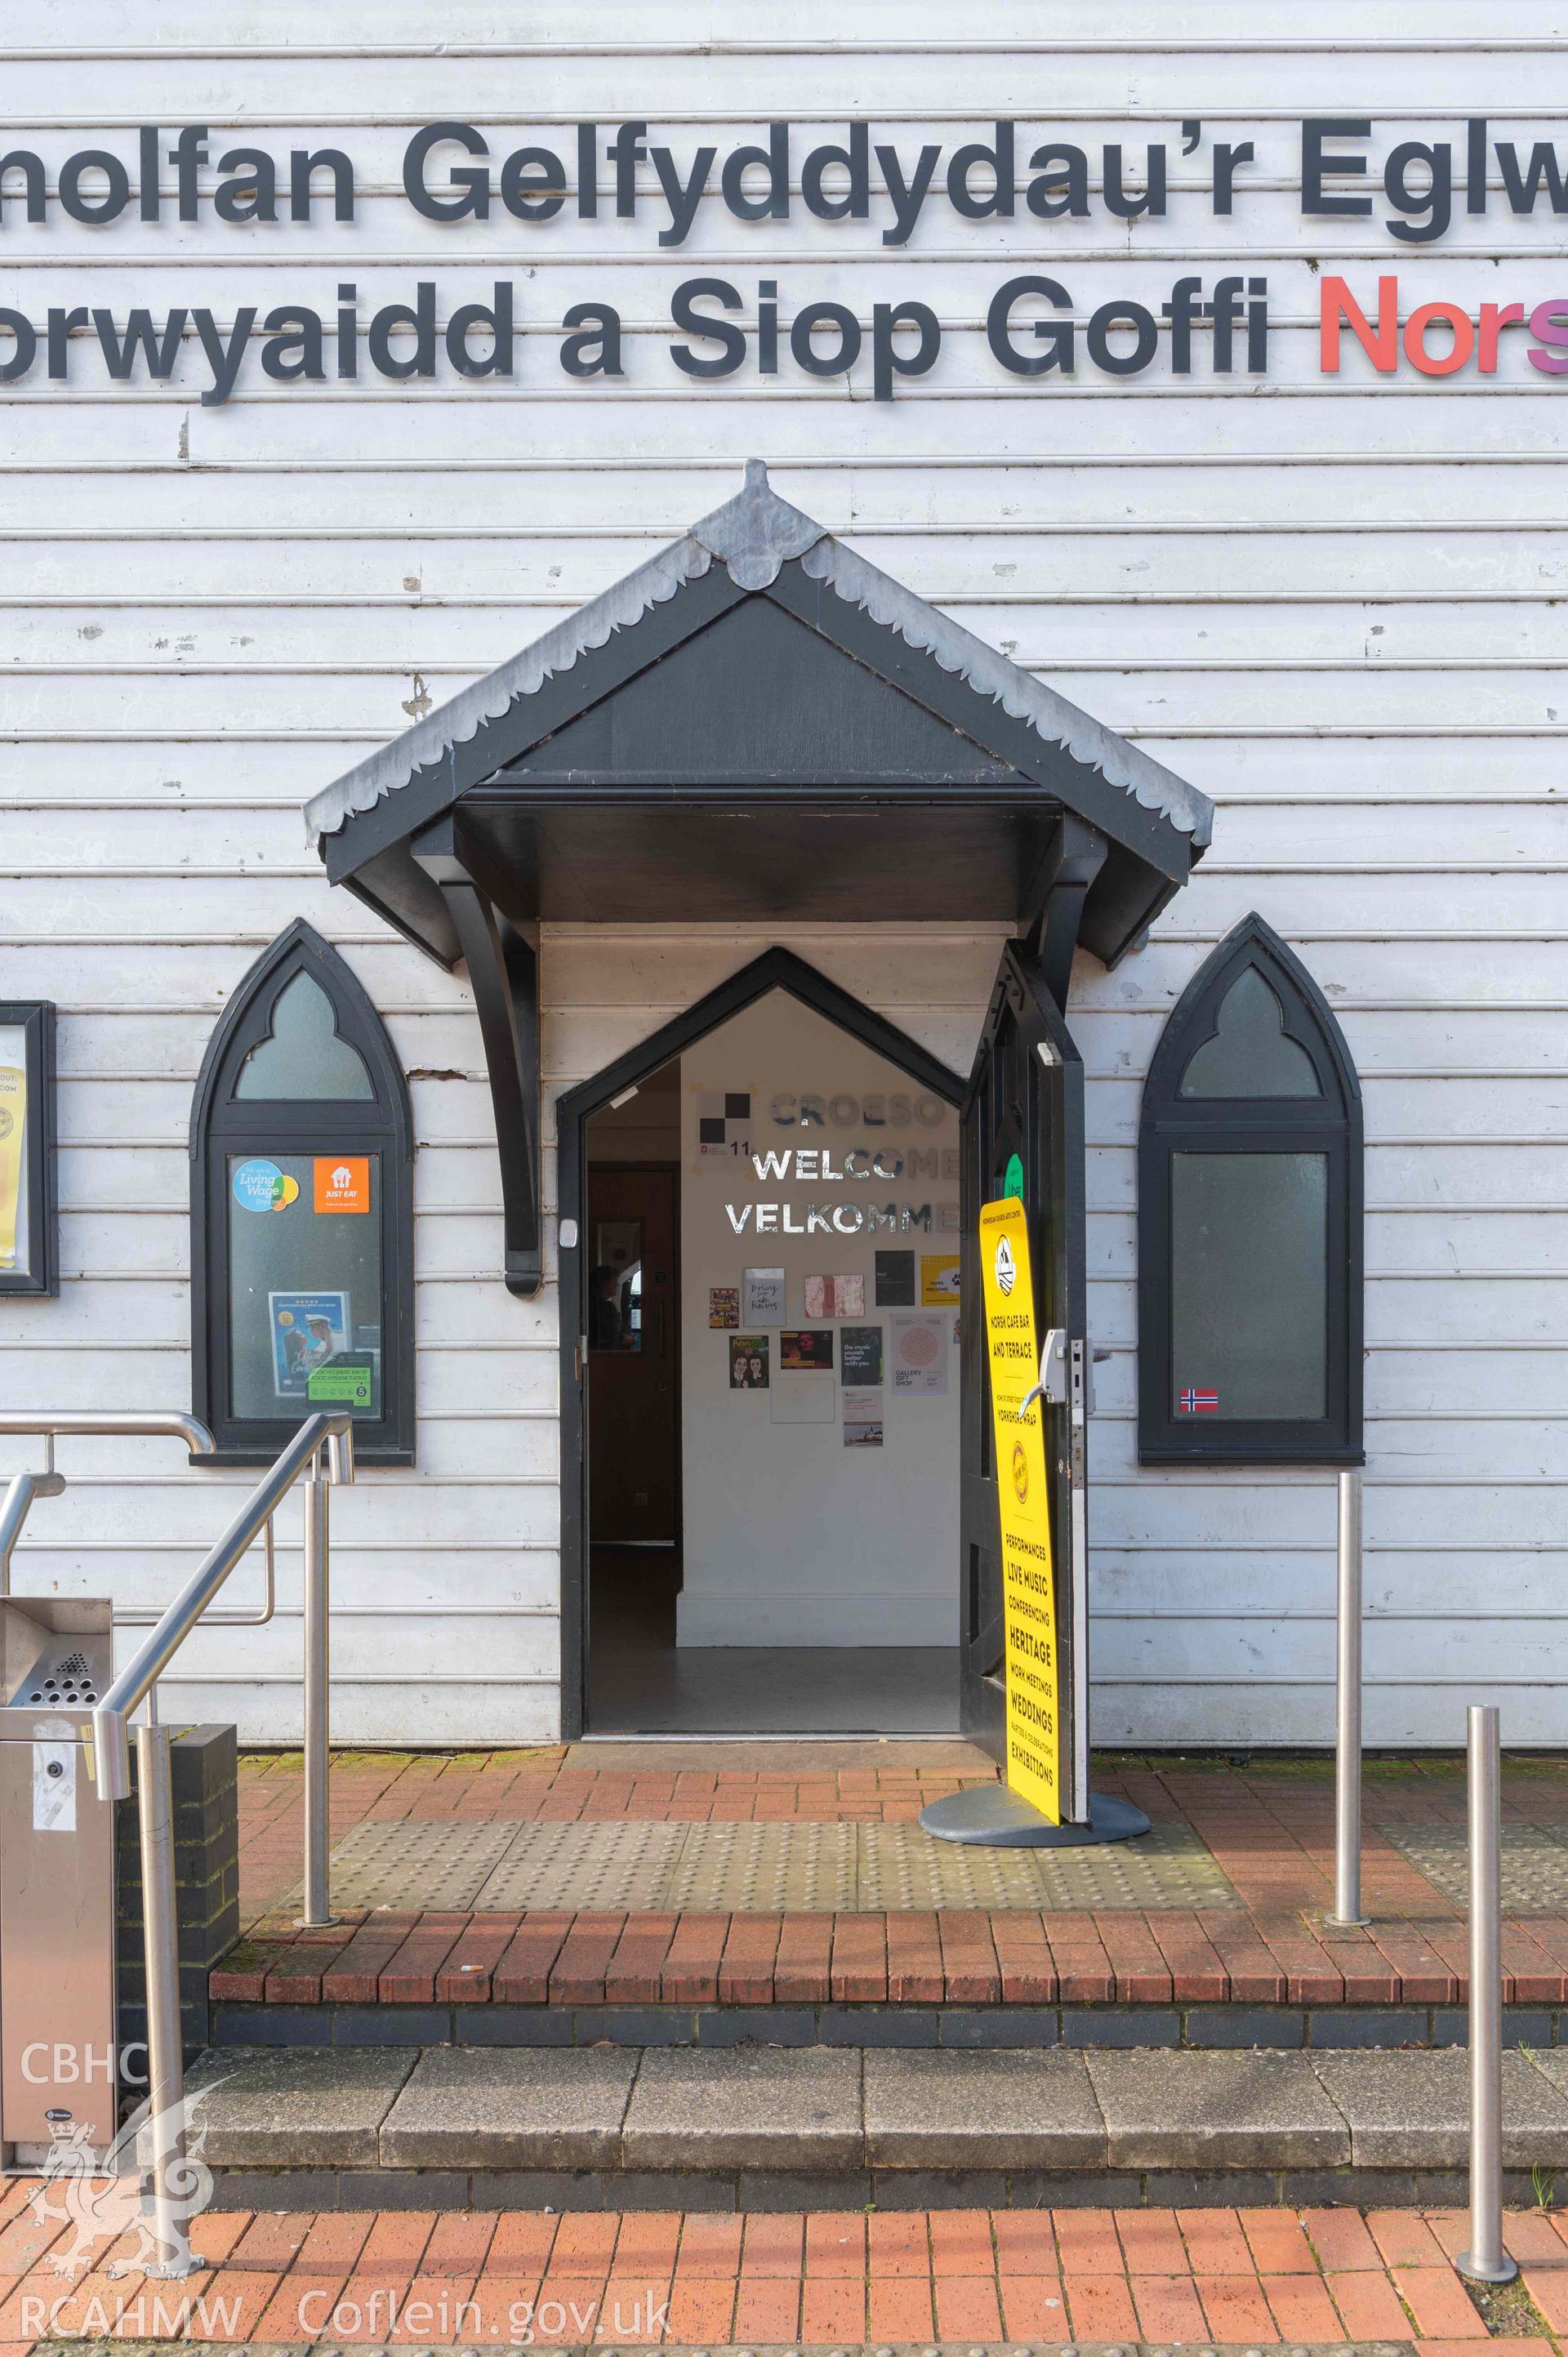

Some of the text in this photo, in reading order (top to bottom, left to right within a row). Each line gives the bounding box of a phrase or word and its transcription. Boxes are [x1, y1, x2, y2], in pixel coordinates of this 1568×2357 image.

[401, 119, 1254, 247] Gelfyddydau'r
[1302, 118, 1568, 243] Eglw
[560, 303, 624, 376] a
[670, 278, 942, 402] Siop
[987, 276, 1267, 376] Goffi
[1321, 276, 1568, 376] Nors
[771, 1095, 946, 1125] CROESO
[730, 1141, 749, 1156] 11
[752, 1149, 960, 1180] WELCOME
[239, 1174, 275, 1187] Living
[247, 1184, 280, 1198] Wage
[991, 1315, 1030, 1329] NORSK CAFE BAR
[994, 1342, 1031, 1359] AND TERRACE
[359, 1388, 365, 1396] 5
[1023, 1413, 1036, 1426] WRAP
[1006, 1533, 1046, 1562] PERFORMANCES
[1008, 1562, 1048, 1597] LIVE MUSIC
[1009, 1595, 1049, 1627] CONFERENCING
[1010, 1624, 1051, 1667] HERITAGE
[1010, 1661, 1053, 1698] WORK MEETINGS
[1010, 1689, 1053, 1735] WEDDINGS
[1011, 1741, 1054, 1787] EXHIBITIONS
